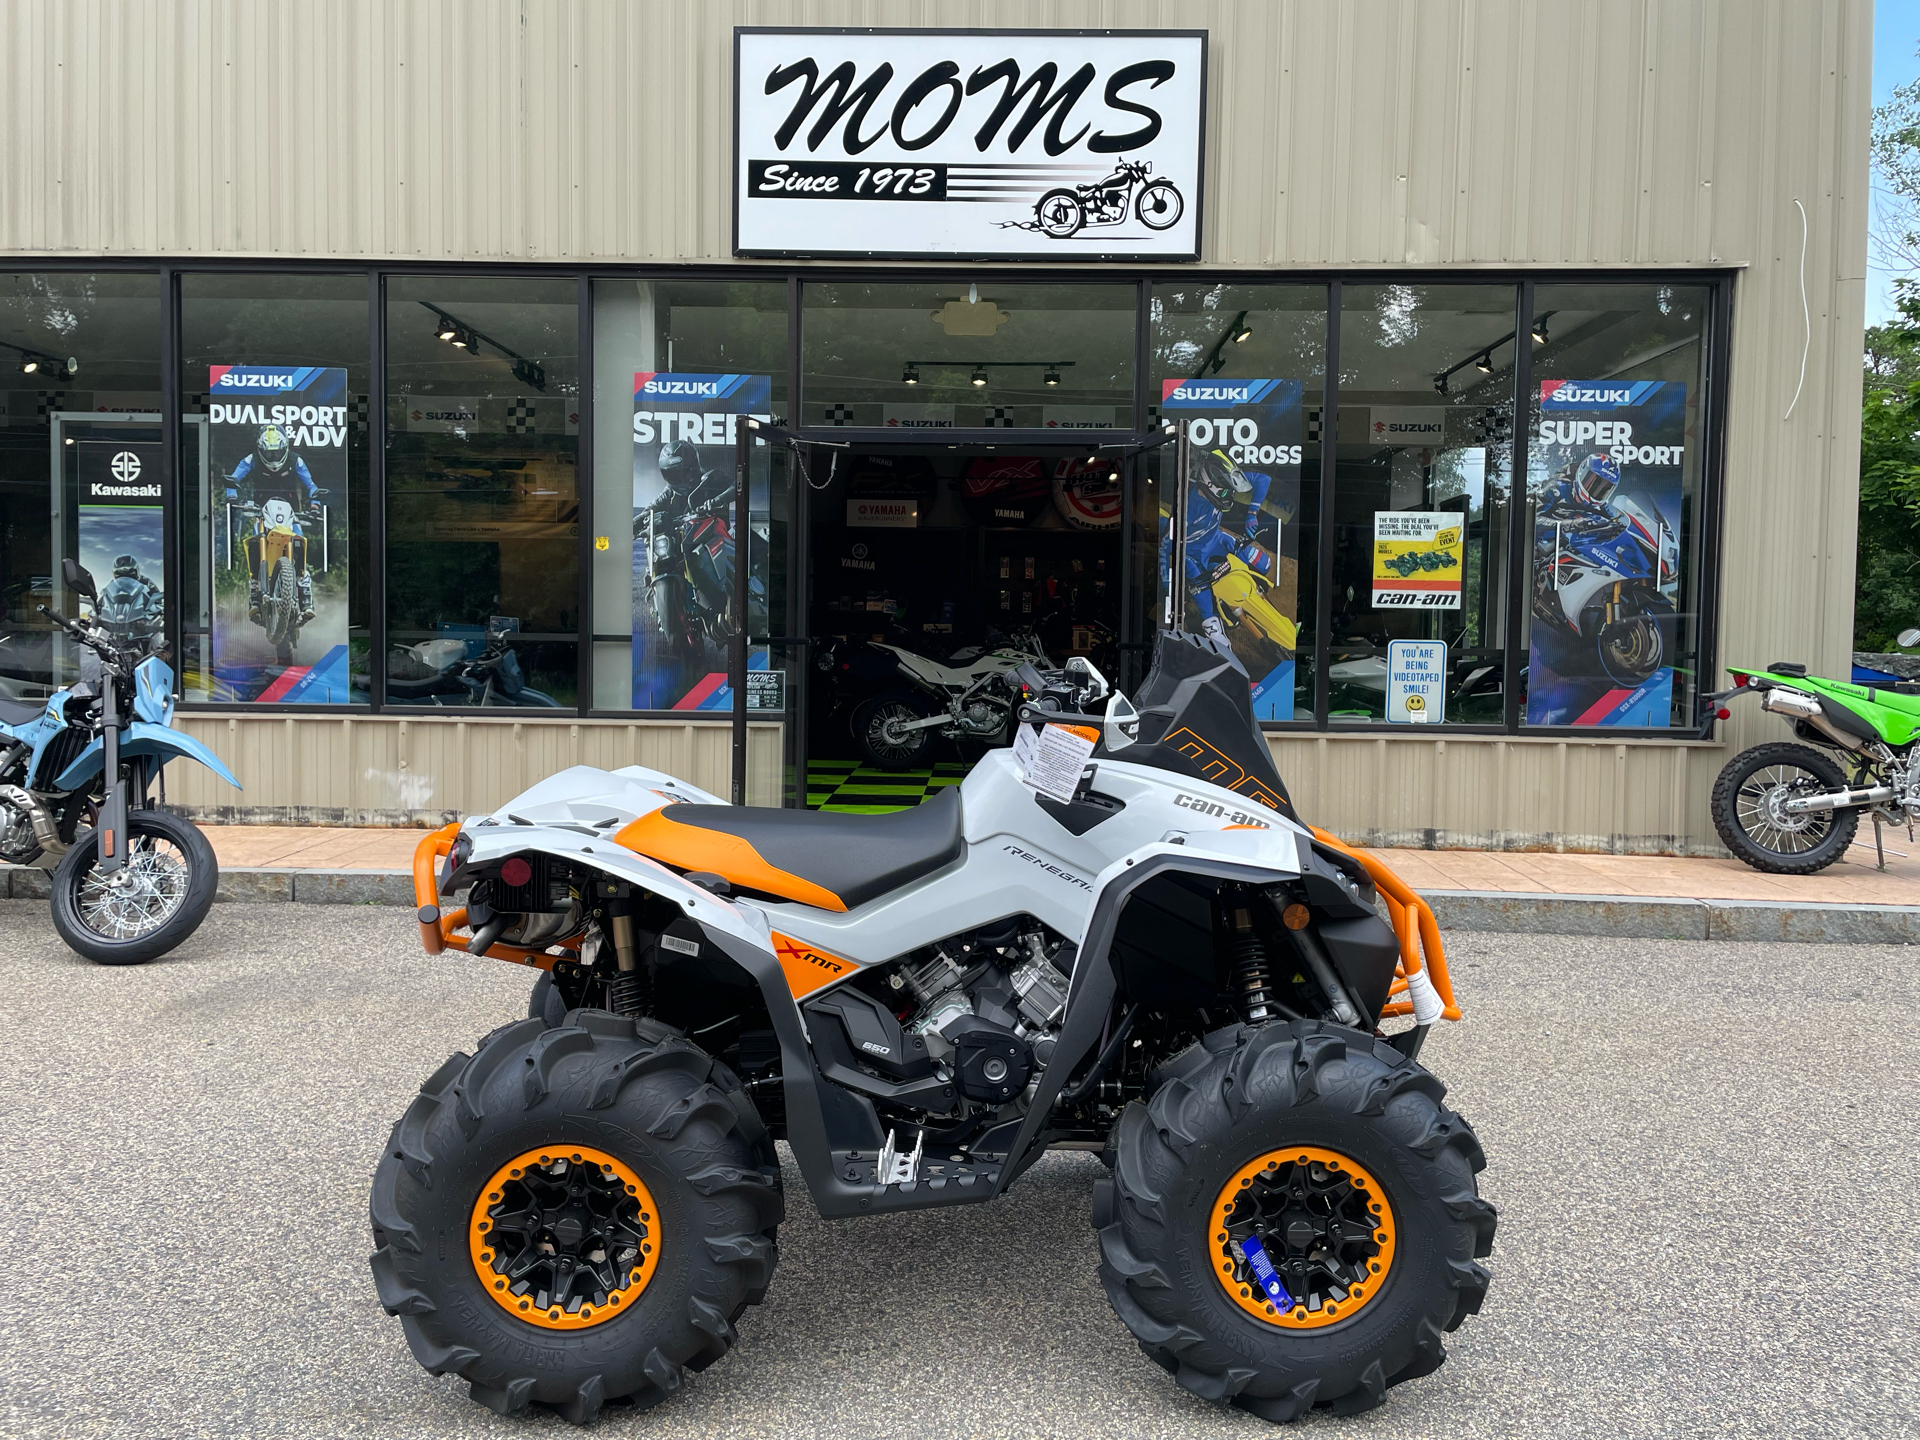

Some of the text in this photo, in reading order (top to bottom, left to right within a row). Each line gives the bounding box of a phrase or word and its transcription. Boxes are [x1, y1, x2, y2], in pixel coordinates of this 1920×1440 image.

[764, 57, 1175, 156] MOMS
[758, 164, 936, 194] Since 1973
[220, 374, 293, 387] SUZUKI
[644, 381, 717, 395] SUZUKI
[1172, 387, 1248, 400] SUZUKI
[1551, 389, 1630, 402] SUZUKI
[210, 404, 347, 426] DUALSPORT
[1388, 422, 1442, 433] SUZUKI
[1539, 420, 1632, 446] SUPER
[1229, 445, 1302, 465] CROSS
[1610, 445, 1685, 466] SPORT
[91, 483, 162, 497] Kawasaki
[868, 505, 907, 515] YAMAHA
[994, 508, 1025, 520] YAMAHA
[1439, 537, 1455, 546] EVENT
[841, 557, 876, 570] YAMAHA
[1591, 547, 1619, 568] SUZUKI
[1376, 593, 1457, 605] can-am
[1401, 648, 1434, 658] YOU ARE
[1405, 660, 1429, 670] BEING
[1394, 672, 1439, 682] VIDEOTAPED
[1403, 684, 1429, 694] SMILE!
[1830, 682, 1865, 697] Kawasaki
[861, 1041, 891, 1055] 650
